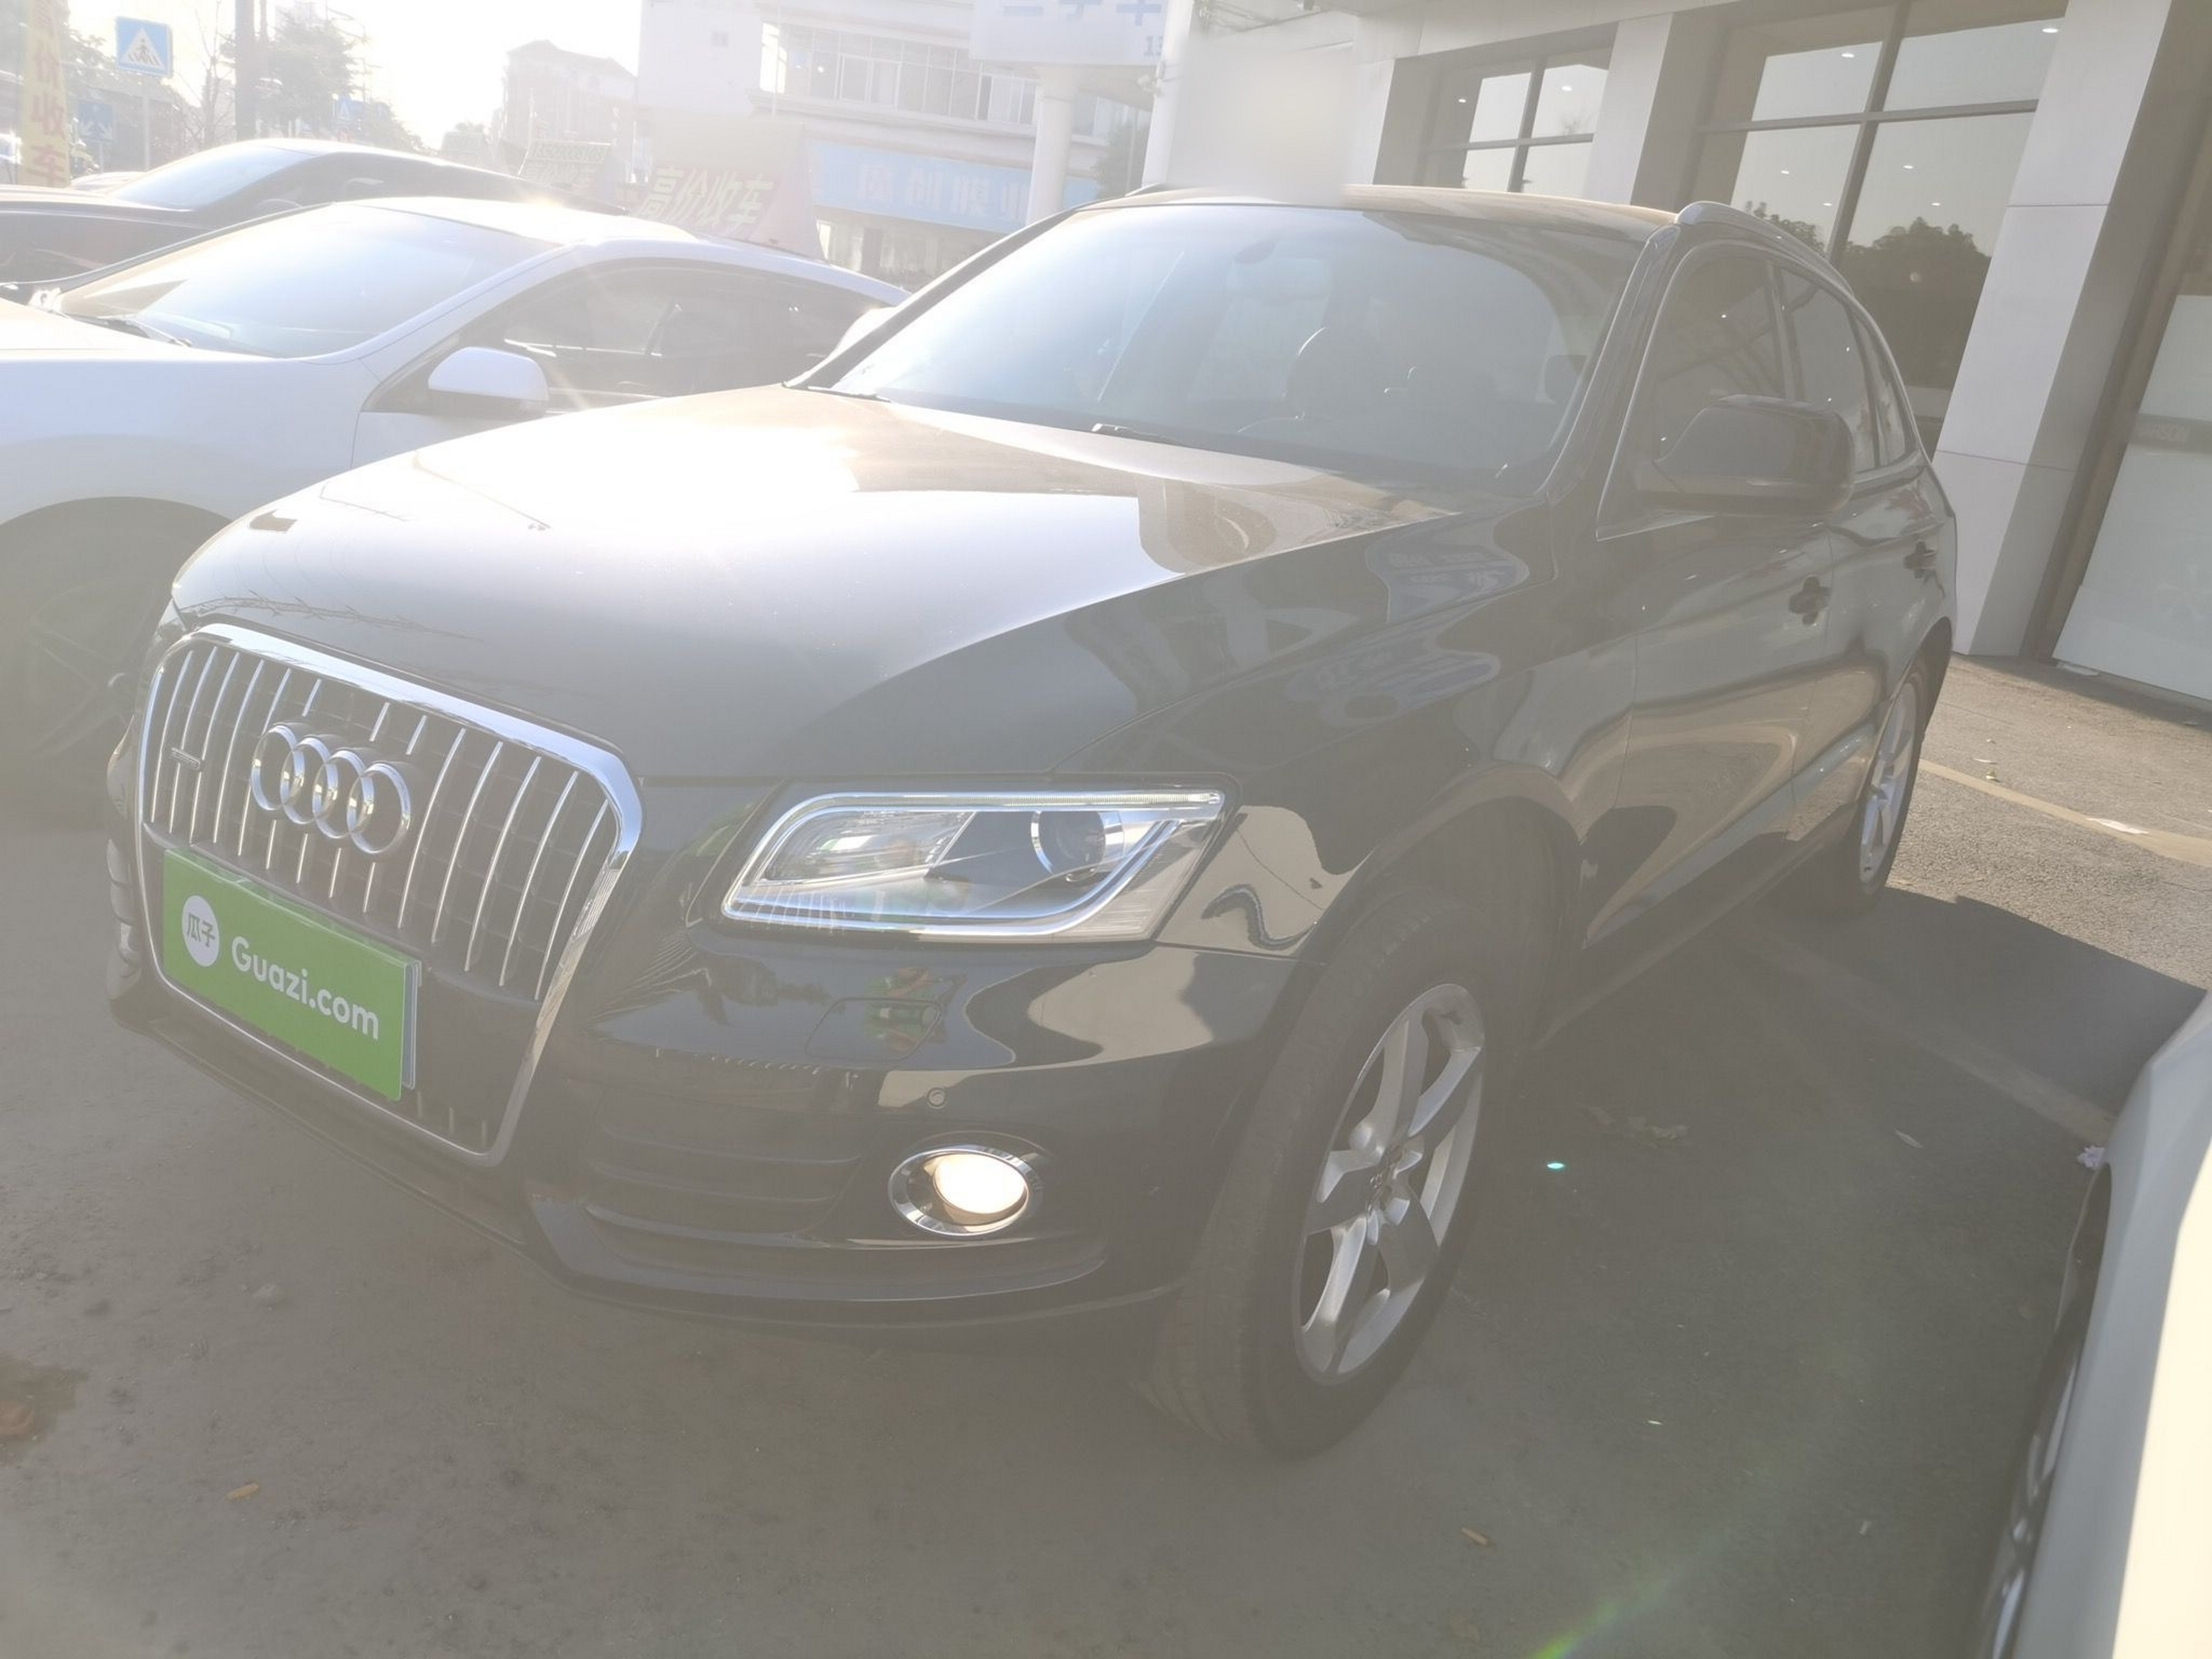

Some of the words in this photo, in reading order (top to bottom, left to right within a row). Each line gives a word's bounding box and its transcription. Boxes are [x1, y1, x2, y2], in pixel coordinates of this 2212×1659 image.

[633, 165, 774, 234] 高价收车
[187, 913, 216, 948] 瓜子
[232, 935, 379, 1041] Guazi.com
